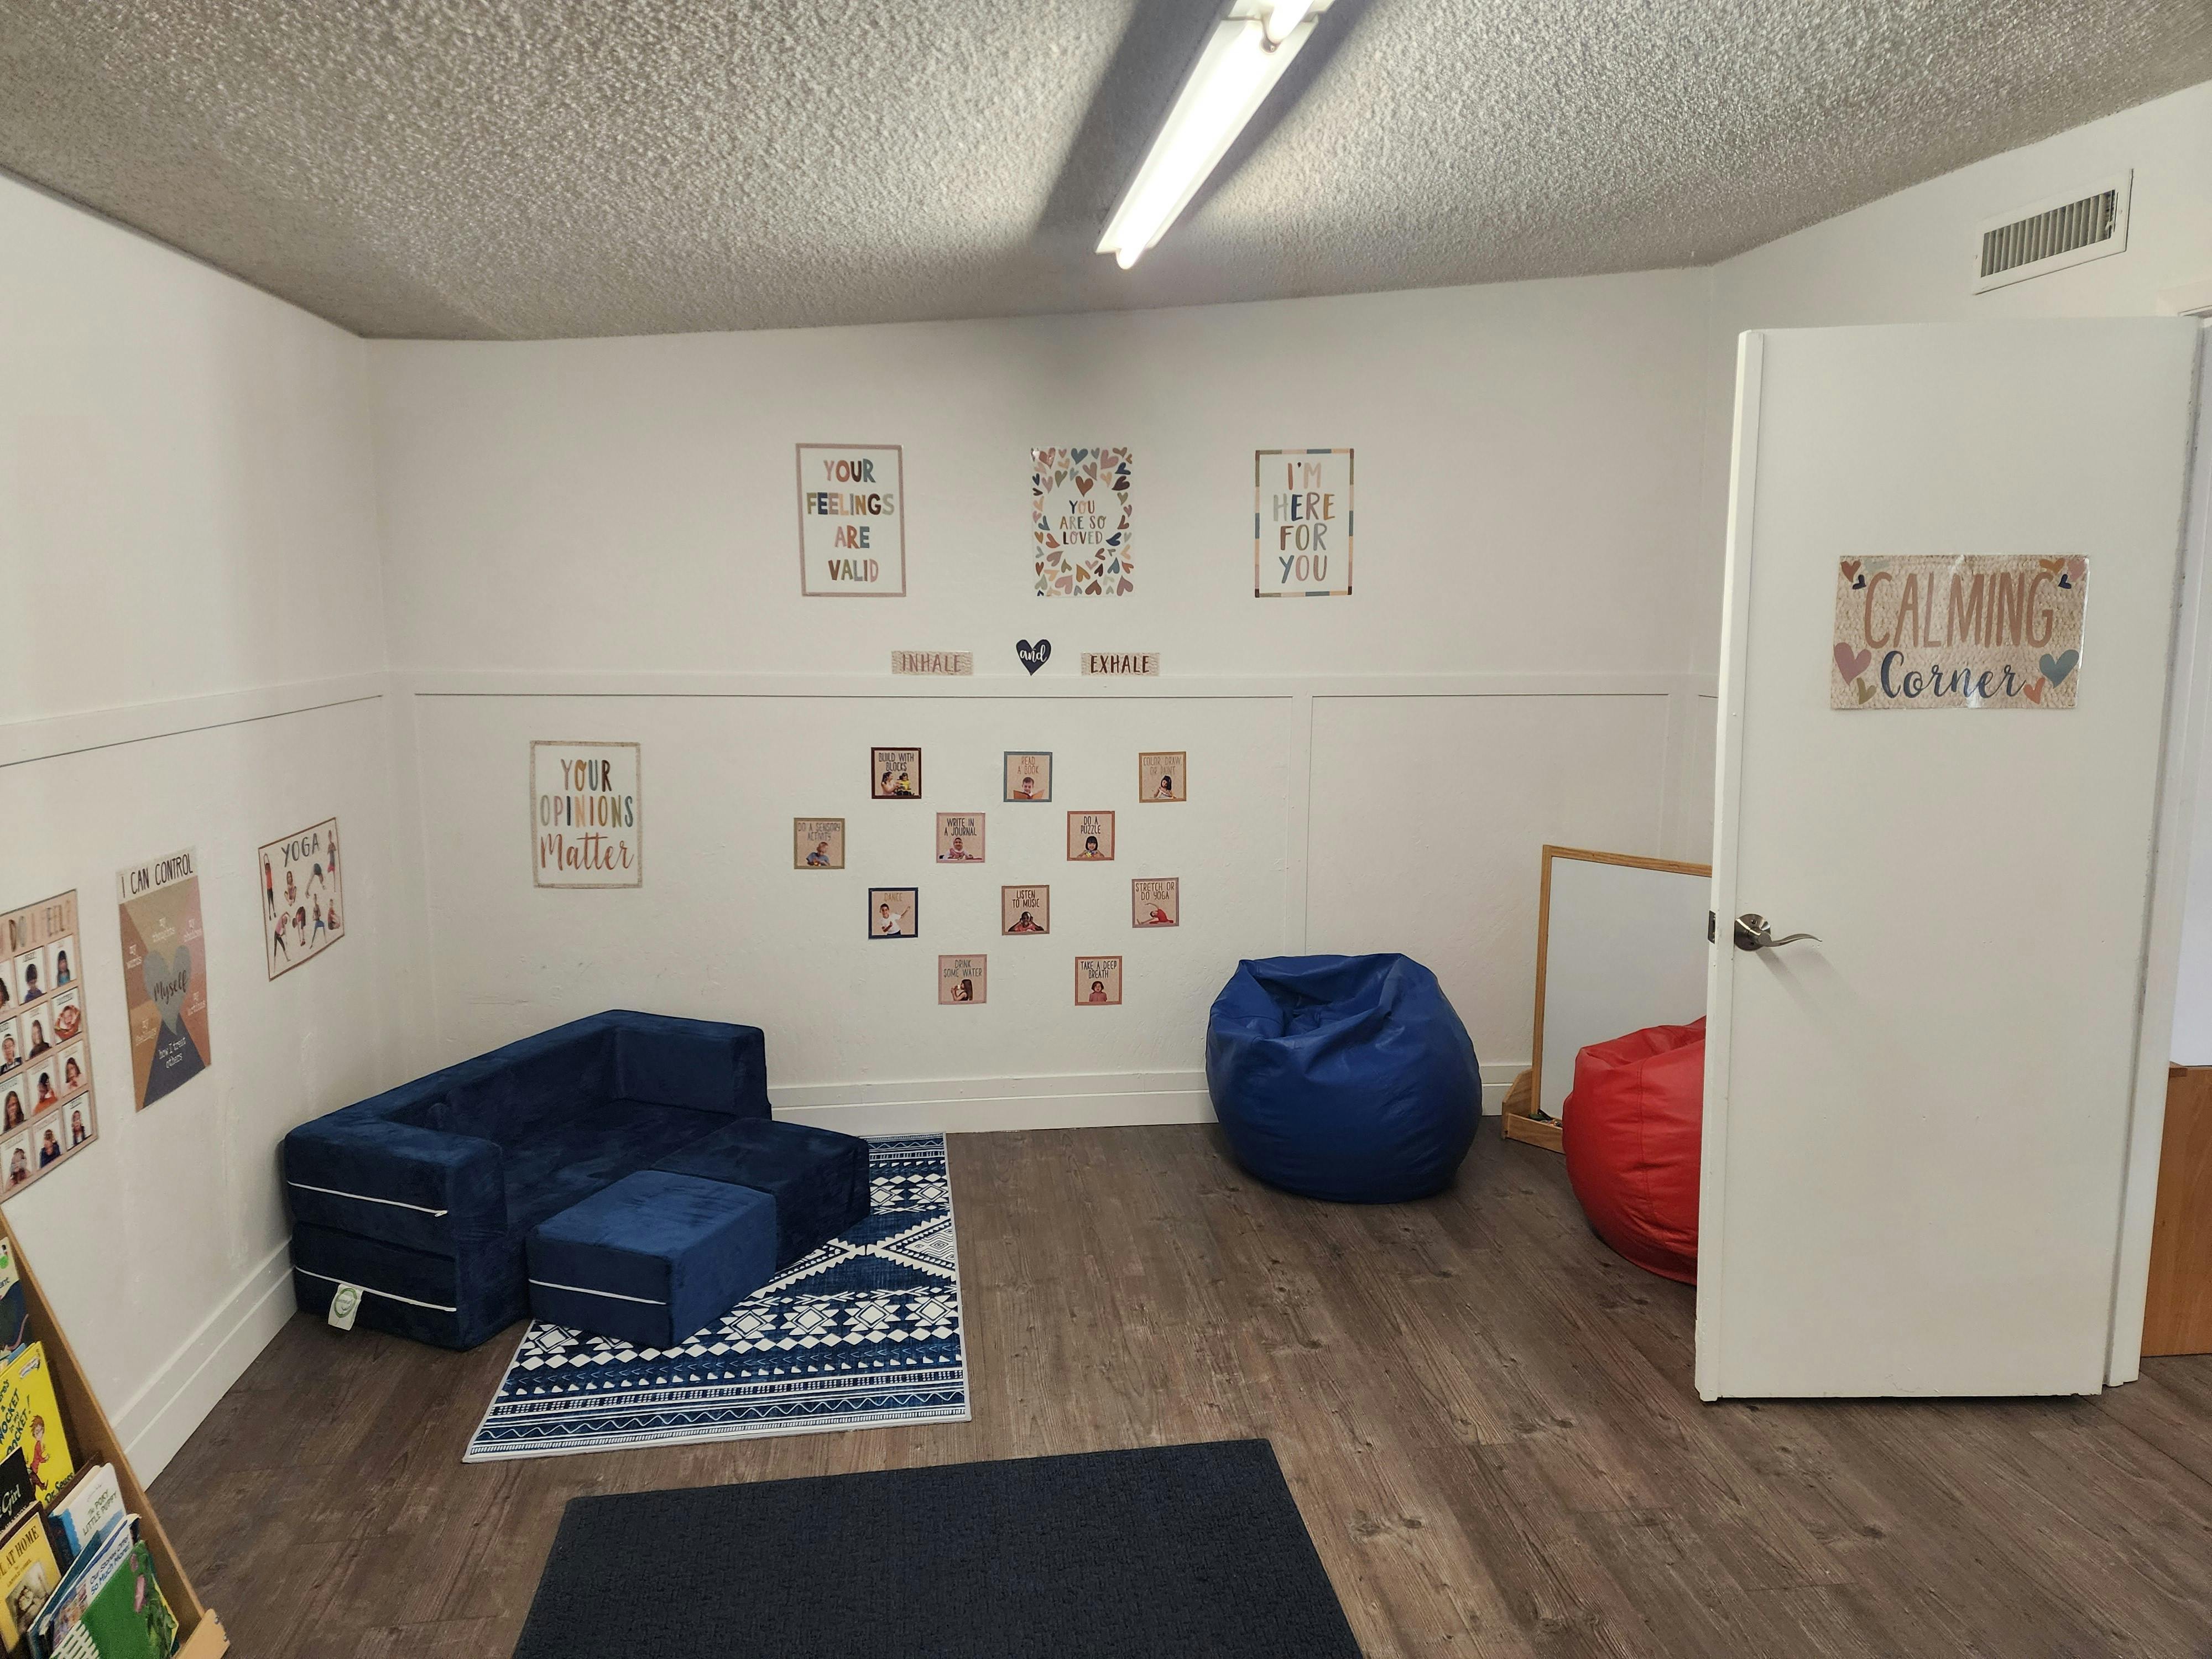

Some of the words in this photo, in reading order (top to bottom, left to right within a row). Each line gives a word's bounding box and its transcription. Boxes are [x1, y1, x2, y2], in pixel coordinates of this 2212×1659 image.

[823, 458, 876, 483] YOUR
[1287, 462, 1322, 490] I'M
[806, 492, 894, 515] FEELINGS
[1069, 499, 1095, 514] YOU
[1274, 492, 1335, 521] HERE
[1060, 515, 1084, 530] ARE
[1089, 515, 1106, 529] SO
[834, 525, 870, 549] ARE
[1063, 531, 1103, 545] LOVED
[1280, 522, 1327, 551] FOR
[828, 559, 879, 582] VALID
[1279, 555, 1327, 584] YOU
[1865, 571, 2053, 649] CALMING
[901, 654, 962, 672] INHALE
[1019, 645, 1047, 663] and
[1090, 654, 1150, 674] EXHALE
[1881, 650, 2026, 698] Corner
[878, 752, 895, 762] BUILD
[899, 752, 914, 762] WITH
[886, 761, 907, 771] BLOCKS
[1021, 757, 1035, 765] READ
[560, 759, 612, 792] YOUR
[1018, 766, 1021, 774] A
[1024, 765, 1039, 774] BOOK
[540, 795, 634, 828] OPINIONS
[1084, 816, 1092, 825] DO
[1094, 816, 1098, 825] A
[944, 827, 948, 836] A
[951, 827, 977, 836] JOURNAL
[947, 818, 965, 827] WRITE
[968, 818, 974, 827] IN
[1081, 825, 1101, 834] PUZZLE
[281, 833, 320, 868] YOGA
[540, 832, 634, 871] Matter
[121, 876, 126, 899] I
[131, 867, 150, 895] CAN
[155, 853, 194, 886] CONTROL
[1016, 890, 1035, 899] LISTEN
[1135, 882, 1162, 892] STRETCH
[1166, 881, 1175, 891] OR
[1012, 899, 1020, 908] TO
[1022, 898, 1040, 907] MUSIC
[1141, 891, 1150, 901] DO
[1153, 891, 1170, 900] YOGA
[955, 959, 972, 968] DRINK
[1081, 961, 1094, 971] TAKE
[1097, 961, 1100, 970] A
[1103, 961, 1117, 970] DEEP
[943, 968, 959, 978] SOME
[962, 968, 982, 977] WATER
[1088, 969, 1109, 979] BREATH
[154, 970, 187, 1005] Myself
[2, 1484, 22, 1516] Girl
[6, 1549, 16, 1567] AT
[15, 1525, 39, 1557] HOME
